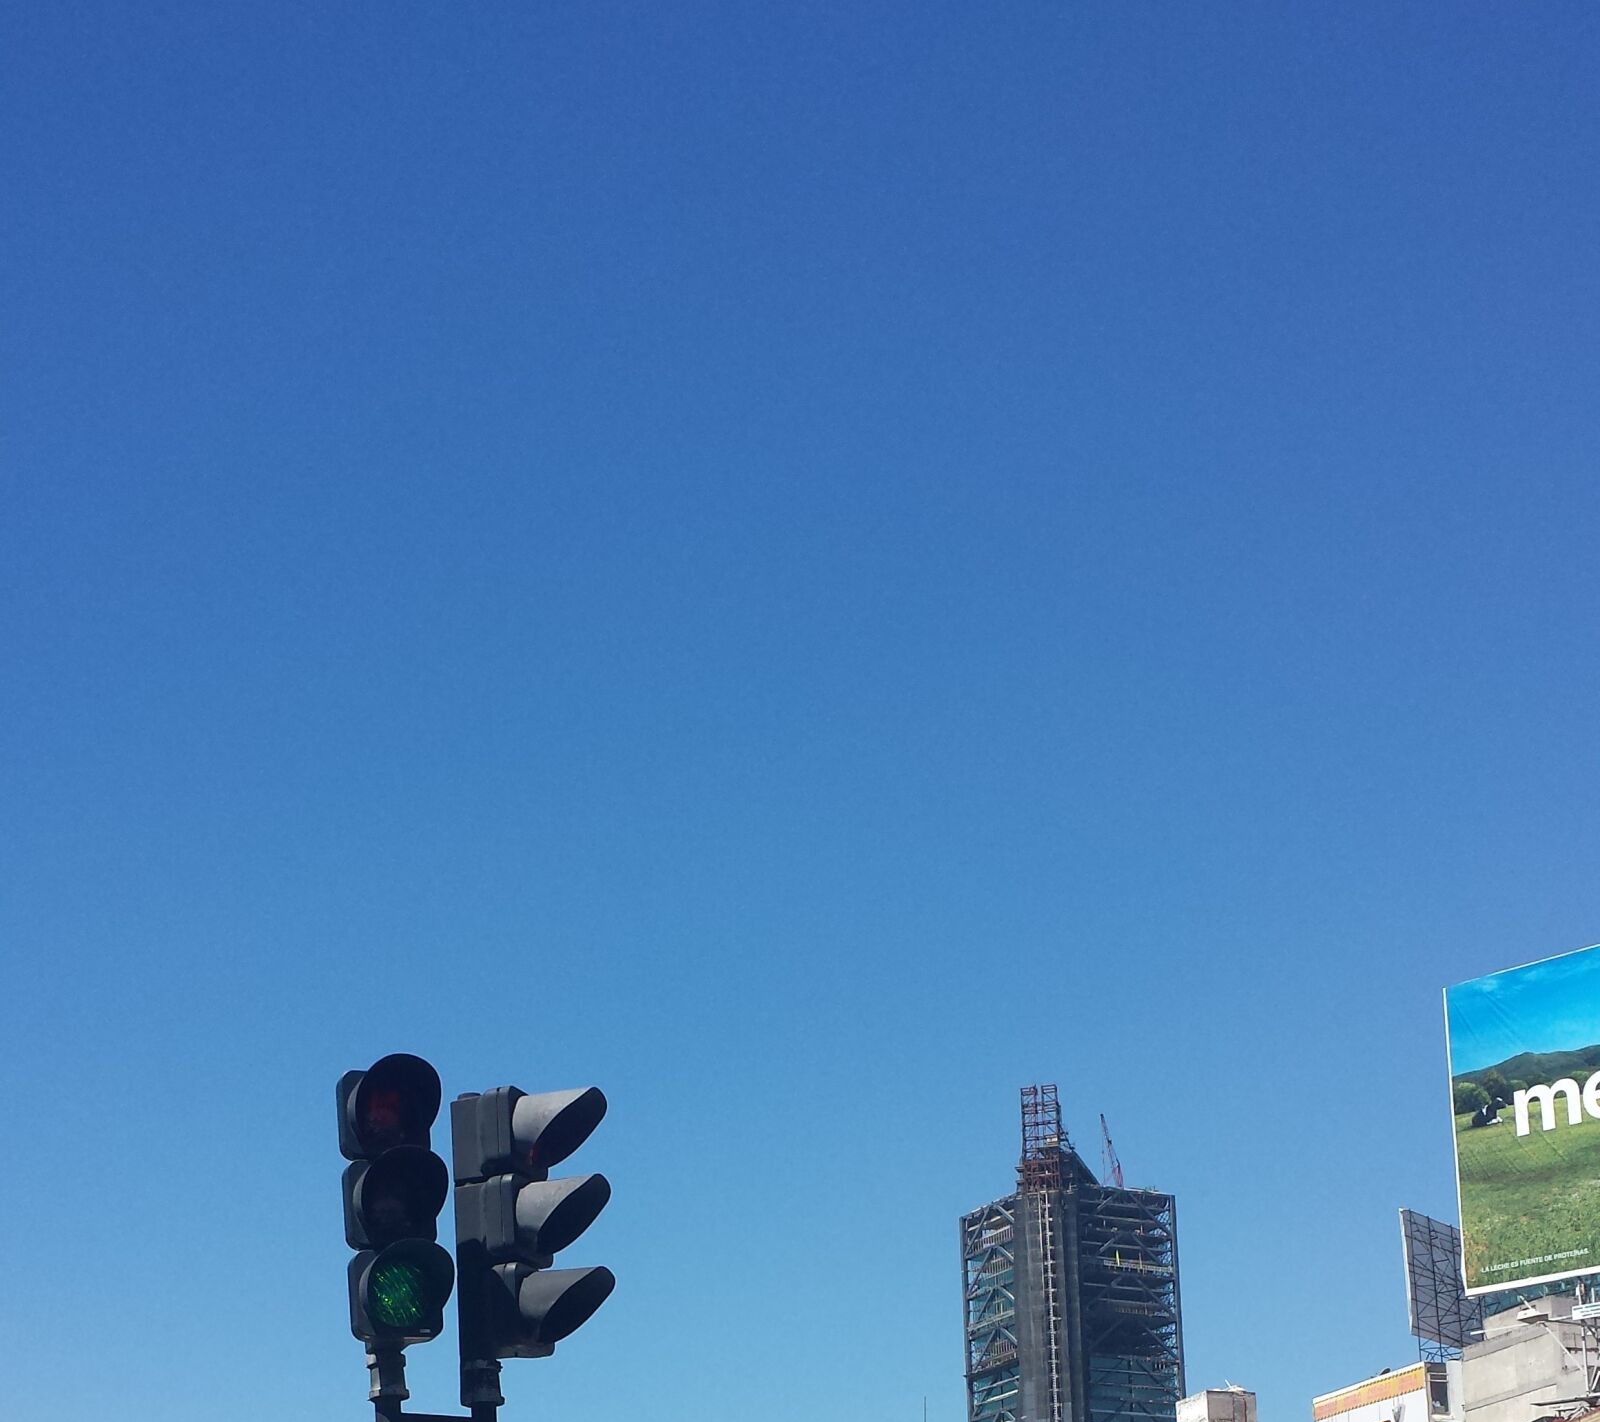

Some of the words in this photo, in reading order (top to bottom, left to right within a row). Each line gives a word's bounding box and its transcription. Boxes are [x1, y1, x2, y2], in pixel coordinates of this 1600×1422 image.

[1481, 1265, 1490, 1273] LA
[1490, 1262, 1510, 1272] LECHE
[1510, 1260, 1519, 1268] ES
[1519, 1256, 1543, 1266] FUENTE
[1544, 1253, 1553, 1261] DE
